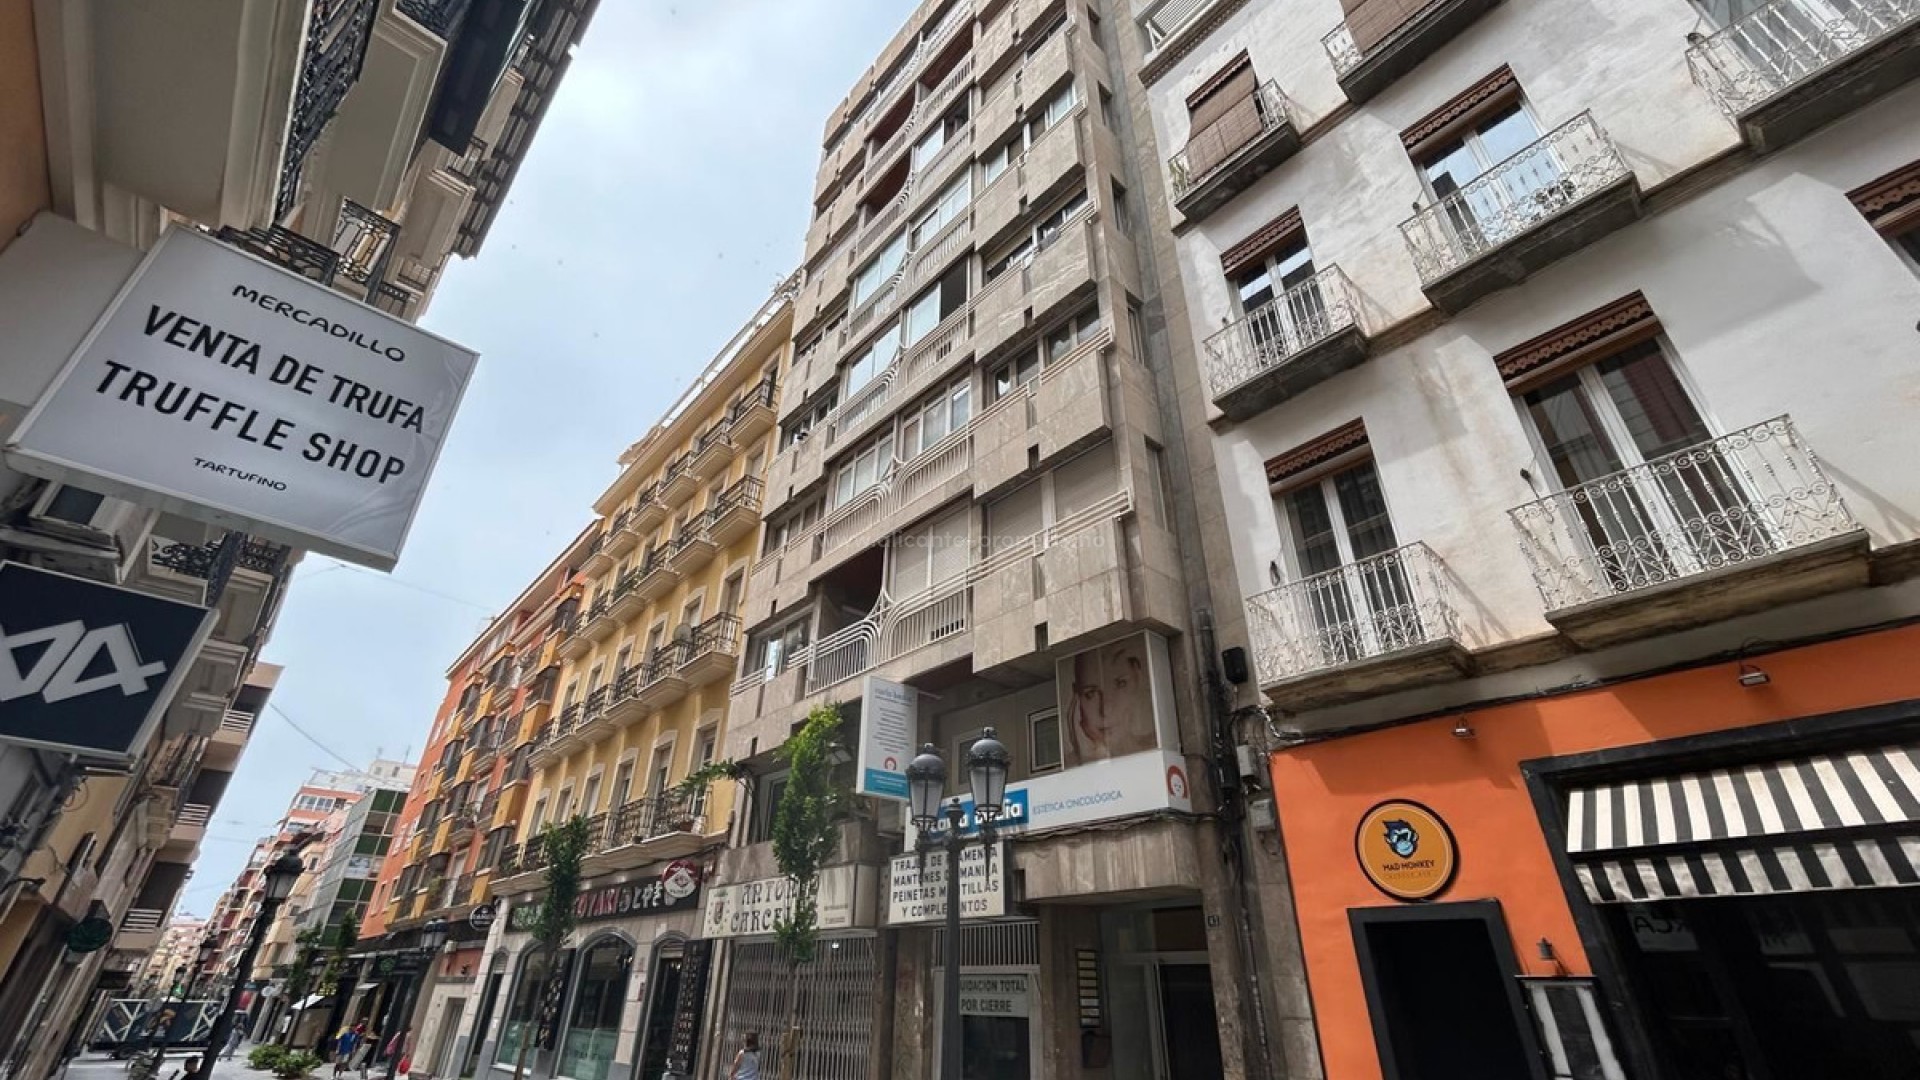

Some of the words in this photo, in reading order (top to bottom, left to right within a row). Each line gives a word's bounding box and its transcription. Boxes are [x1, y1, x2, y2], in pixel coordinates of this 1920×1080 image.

[232, 284, 405, 363] MERCADILLO
[144, 305, 262, 376] VENTA
[270, 354, 324, 396] DE
[328, 374, 425, 434] TRUFA
[96, 361, 295, 451] TRUFFLE
[302, 431, 406, 485] SHOP
[194, 457, 288, 492] TARTUFINO
[894, 870, 942, 887] MANTNES
[960, 862, 998, 878] MANIA
[1382, 862, 1400, 872] MAD
[1401, 859, 1435, 870] MONKEY
[893, 886, 936, 904] PEINETAS
[902, 906, 908, 918] Y
[911, 899, 988, 917] COMPLENTOS
[999, 979, 1027, 993] TOTAL
[960, 998, 978, 1012] POR
[980, 998, 1012, 1013] CIERRE
